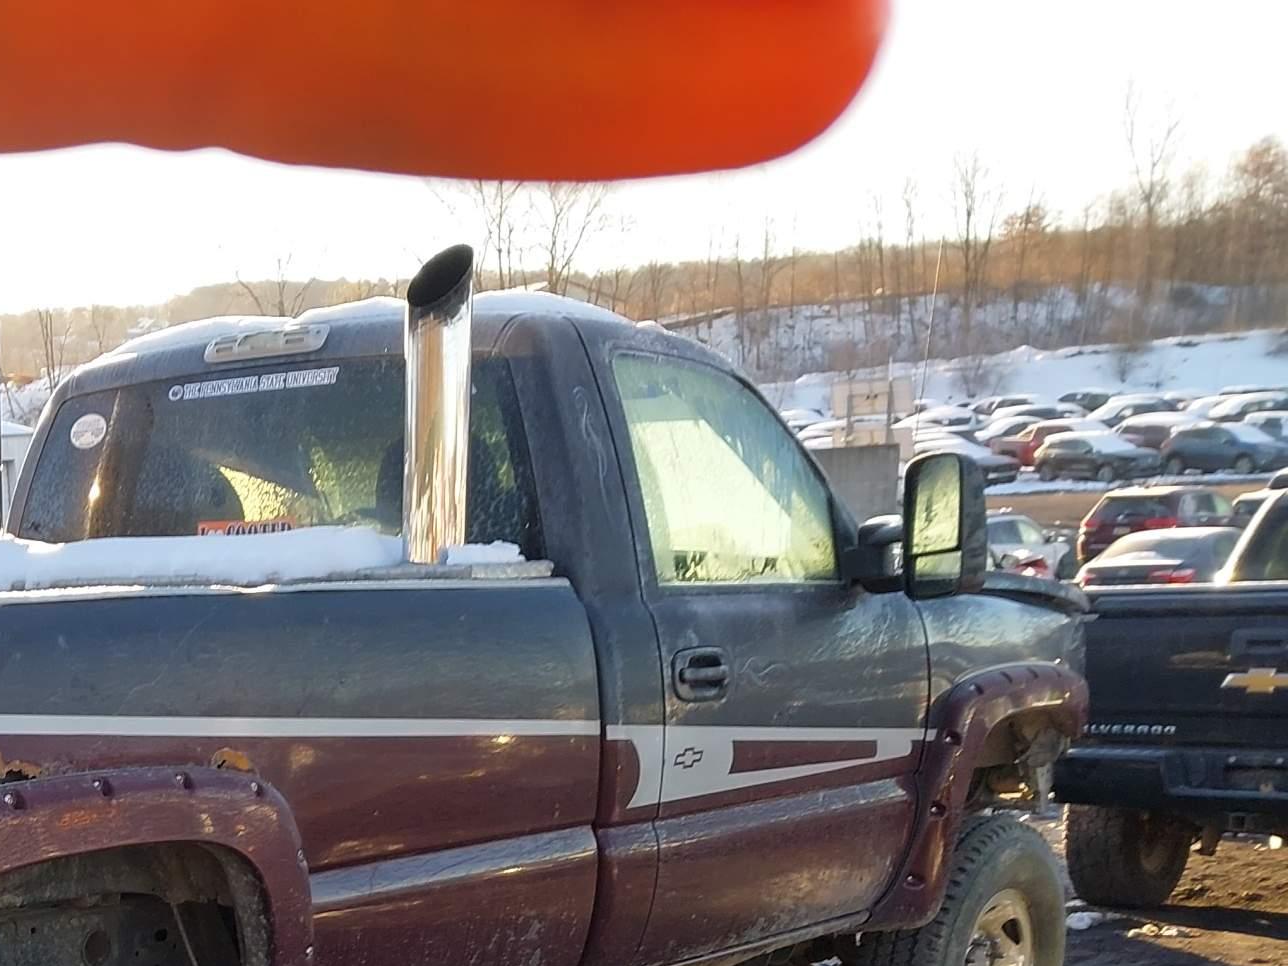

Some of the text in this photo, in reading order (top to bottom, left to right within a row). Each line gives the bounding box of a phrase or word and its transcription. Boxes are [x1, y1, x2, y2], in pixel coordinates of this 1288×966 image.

[200, 376, 259, 398] PENNSYLVANIA
[258, 373, 286, 391] STATE
[285, 366, 340, 389] UNIVERSITY
[1082, 723, 1177, 735] ILVERADO
